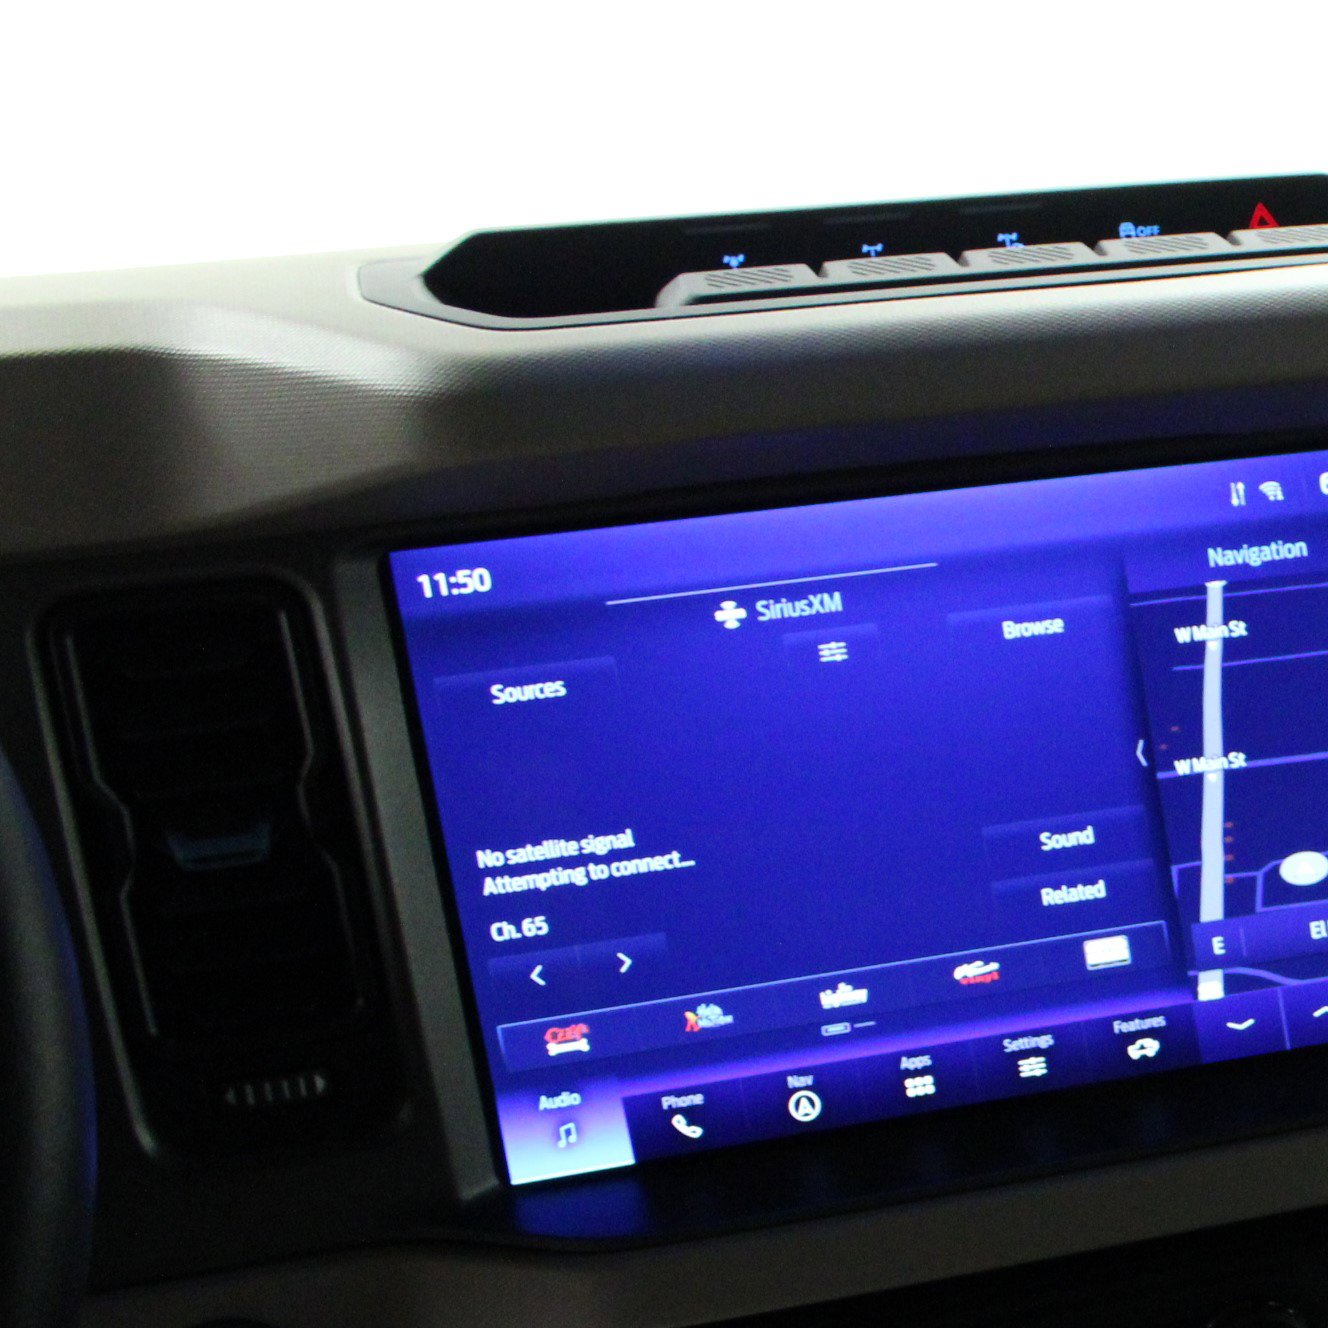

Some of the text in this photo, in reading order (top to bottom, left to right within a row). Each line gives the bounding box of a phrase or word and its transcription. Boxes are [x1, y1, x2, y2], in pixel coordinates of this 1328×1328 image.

[1135, 225, 1161, 237] OFF
[1207, 539, 1309, 568] Navigation
[416, 567, 492, 599] 11:50
[755, 591, 843, 622] SiriusXM
[1001, 617, 1065, 640] Browse
[1228, 619, 1248, 637] St
[489, 680, 567, 705] Sources
[475, 828, 636, 869] No satellite signal
[1039, 825, 1096, 852] Sound
[482, 863, 588, 898] Attempting
[588, 861, 611, 882] to
[1040, 879, 1107, 907] Related
[489, 915, 550, 943] Ch. 65
[1308, 919, 1328, 940] El
[1211, 935, 1226, 955] E
[1112, 1014, 1167, 1035] Features
[1002, 1034, 1055, 1055] Settings
[899, 1053, 933, 1073] Apps
[786, 1074, 814, 1090] Nav
[538, 1091, 582, 1111] Audio
[660, 1092, 705, 1111] Phone
